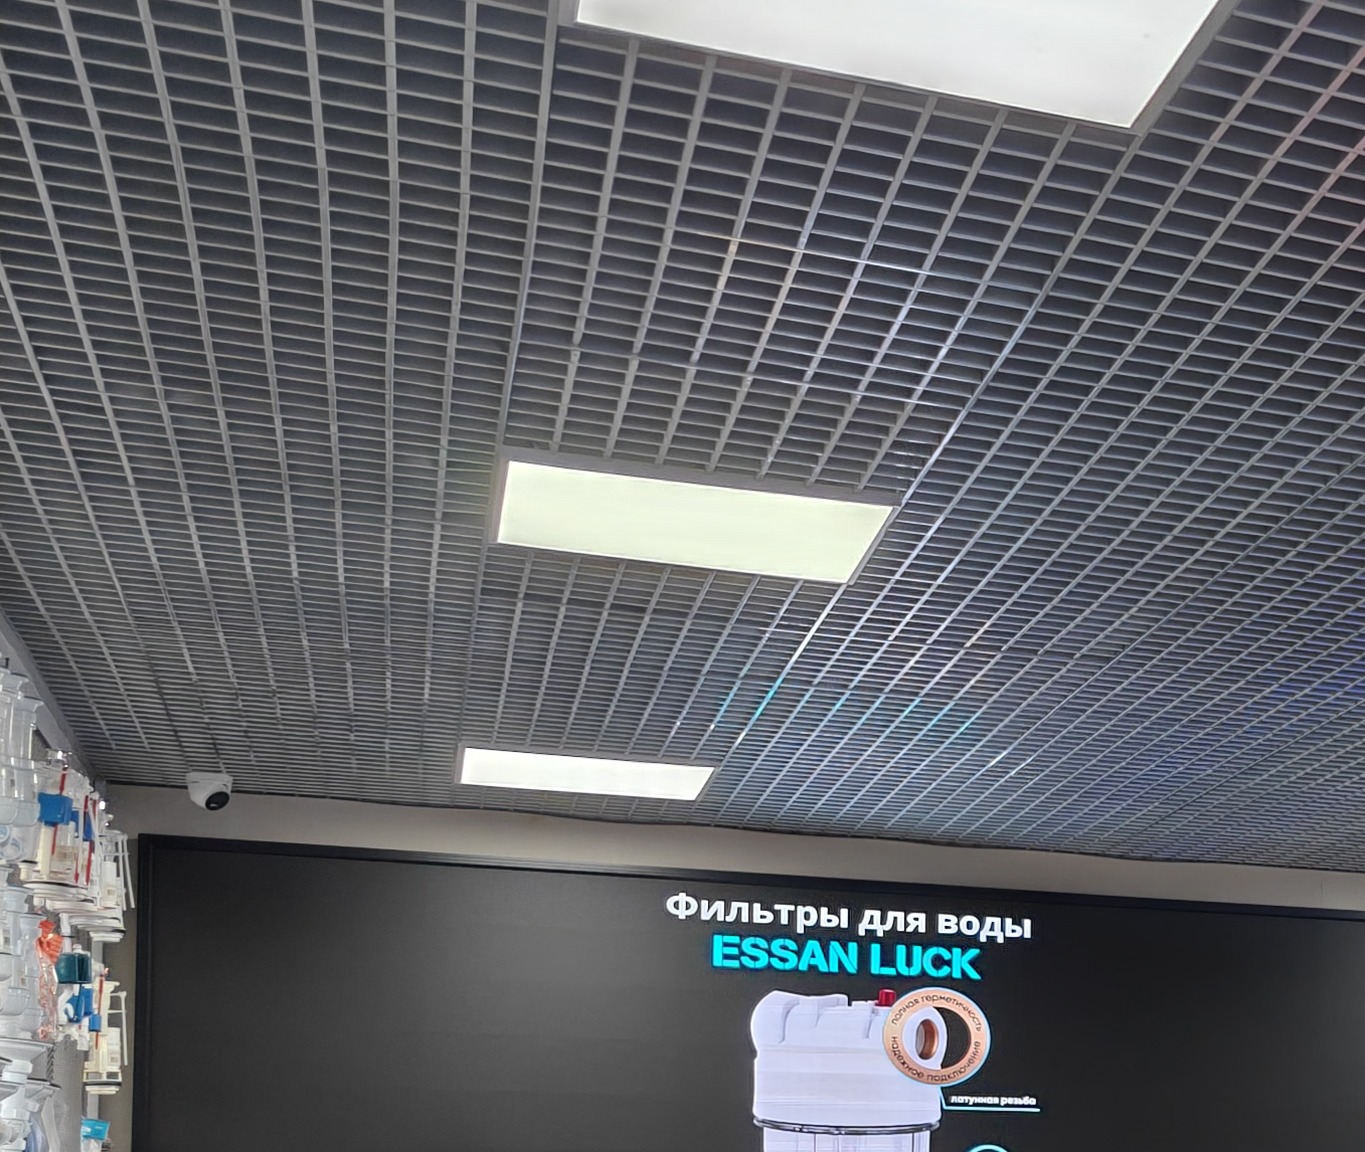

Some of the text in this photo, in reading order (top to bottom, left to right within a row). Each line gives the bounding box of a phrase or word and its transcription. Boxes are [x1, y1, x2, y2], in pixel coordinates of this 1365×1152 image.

[666, 892, 1032, 943] Фильтры для воды
[712, 934, 982, 980] ESSAN LUCK
